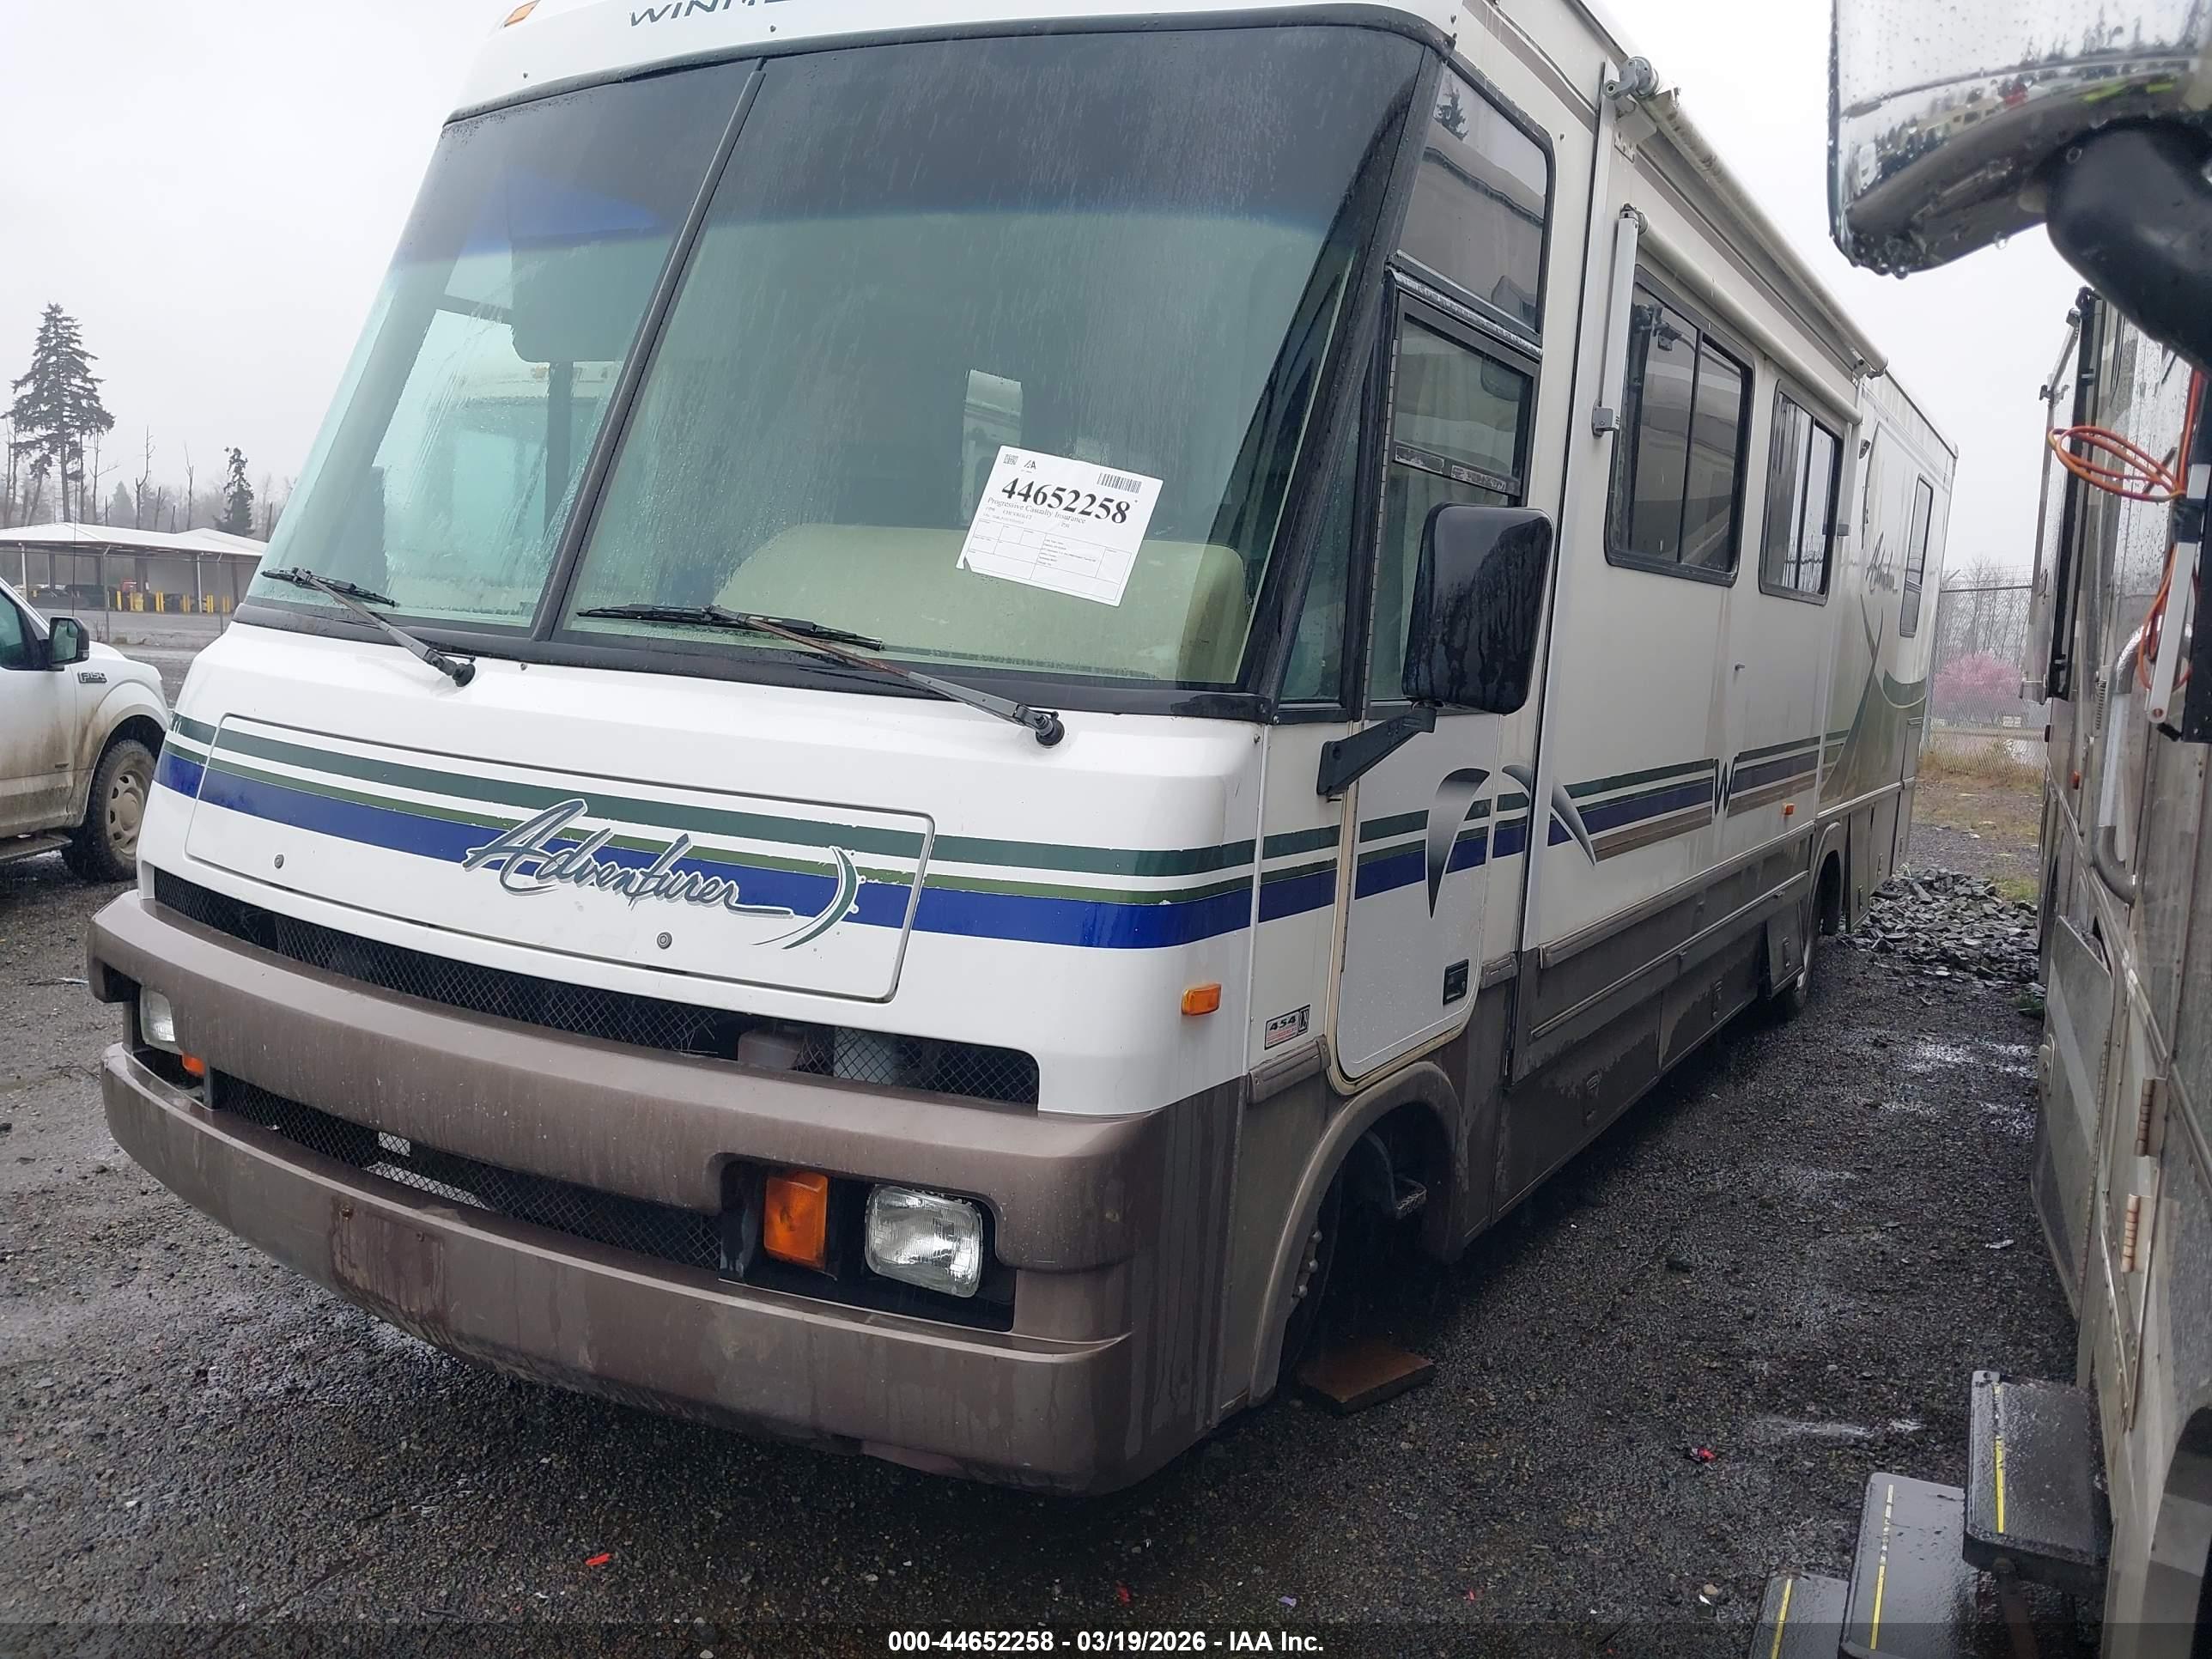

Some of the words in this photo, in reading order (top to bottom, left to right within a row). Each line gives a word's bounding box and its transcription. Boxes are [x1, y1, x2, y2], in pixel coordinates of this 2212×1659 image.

[988, 497, 1024, 510] Progressive
[1024, 506, 1053, 517] Casualty
[1054, 512, 1086, 524] Insurance
[1001, 477, 1130, 524] 44652258
[462, 798, 795, 915] Adventurer
